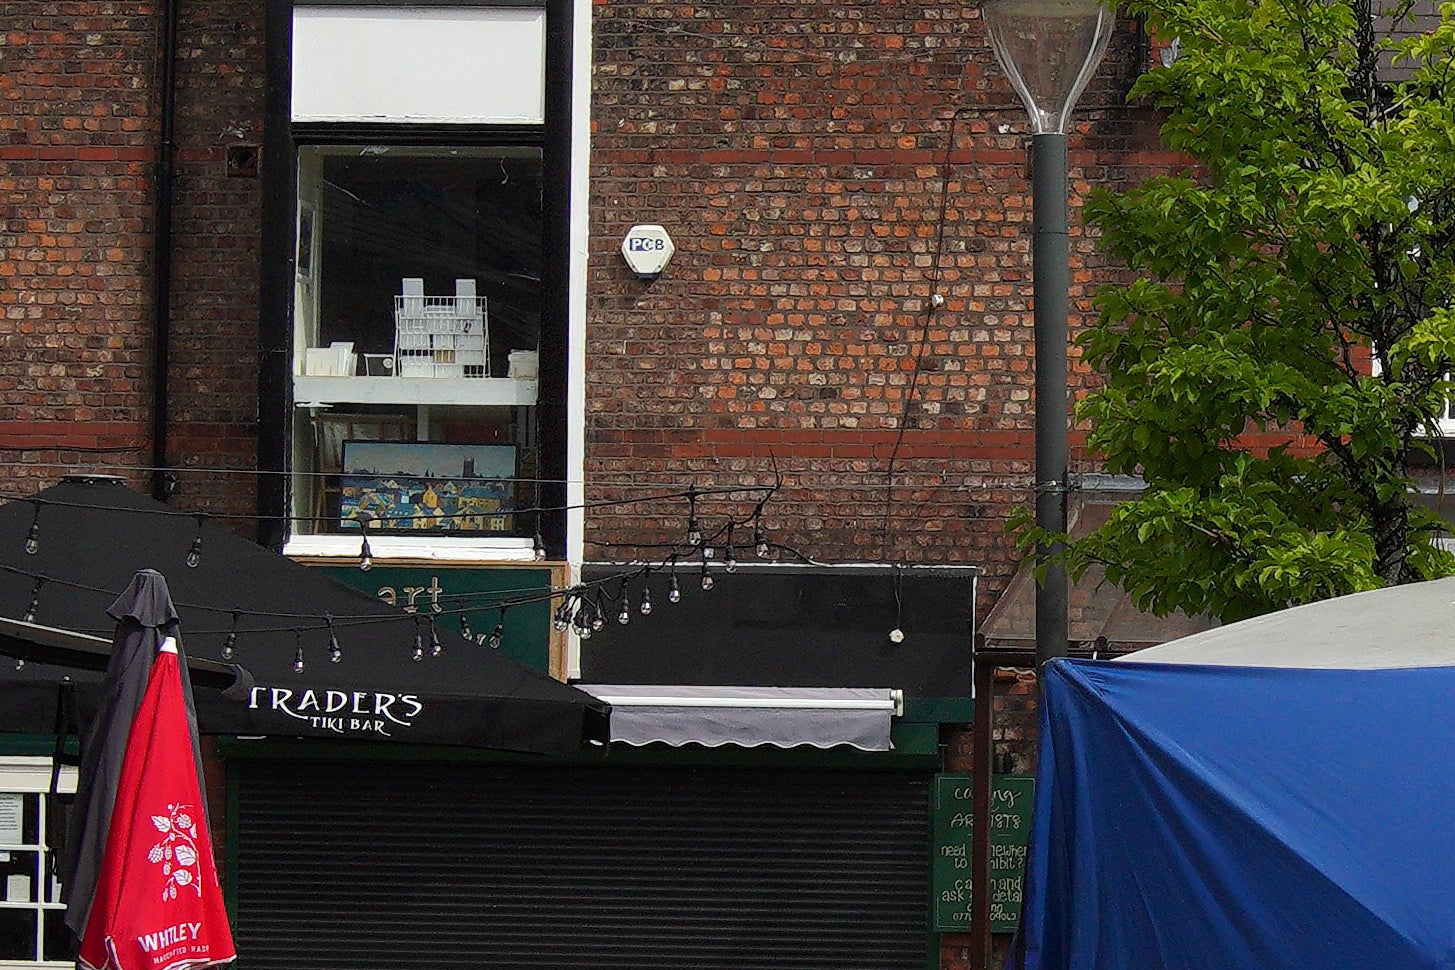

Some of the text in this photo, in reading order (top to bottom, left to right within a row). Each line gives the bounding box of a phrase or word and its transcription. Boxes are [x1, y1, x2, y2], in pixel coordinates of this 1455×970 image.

[630, 238, 664, 251] PCB
[310, 716, 391, 737] TIKI BAR
[138, 922, 202, 952] WHTLEY
